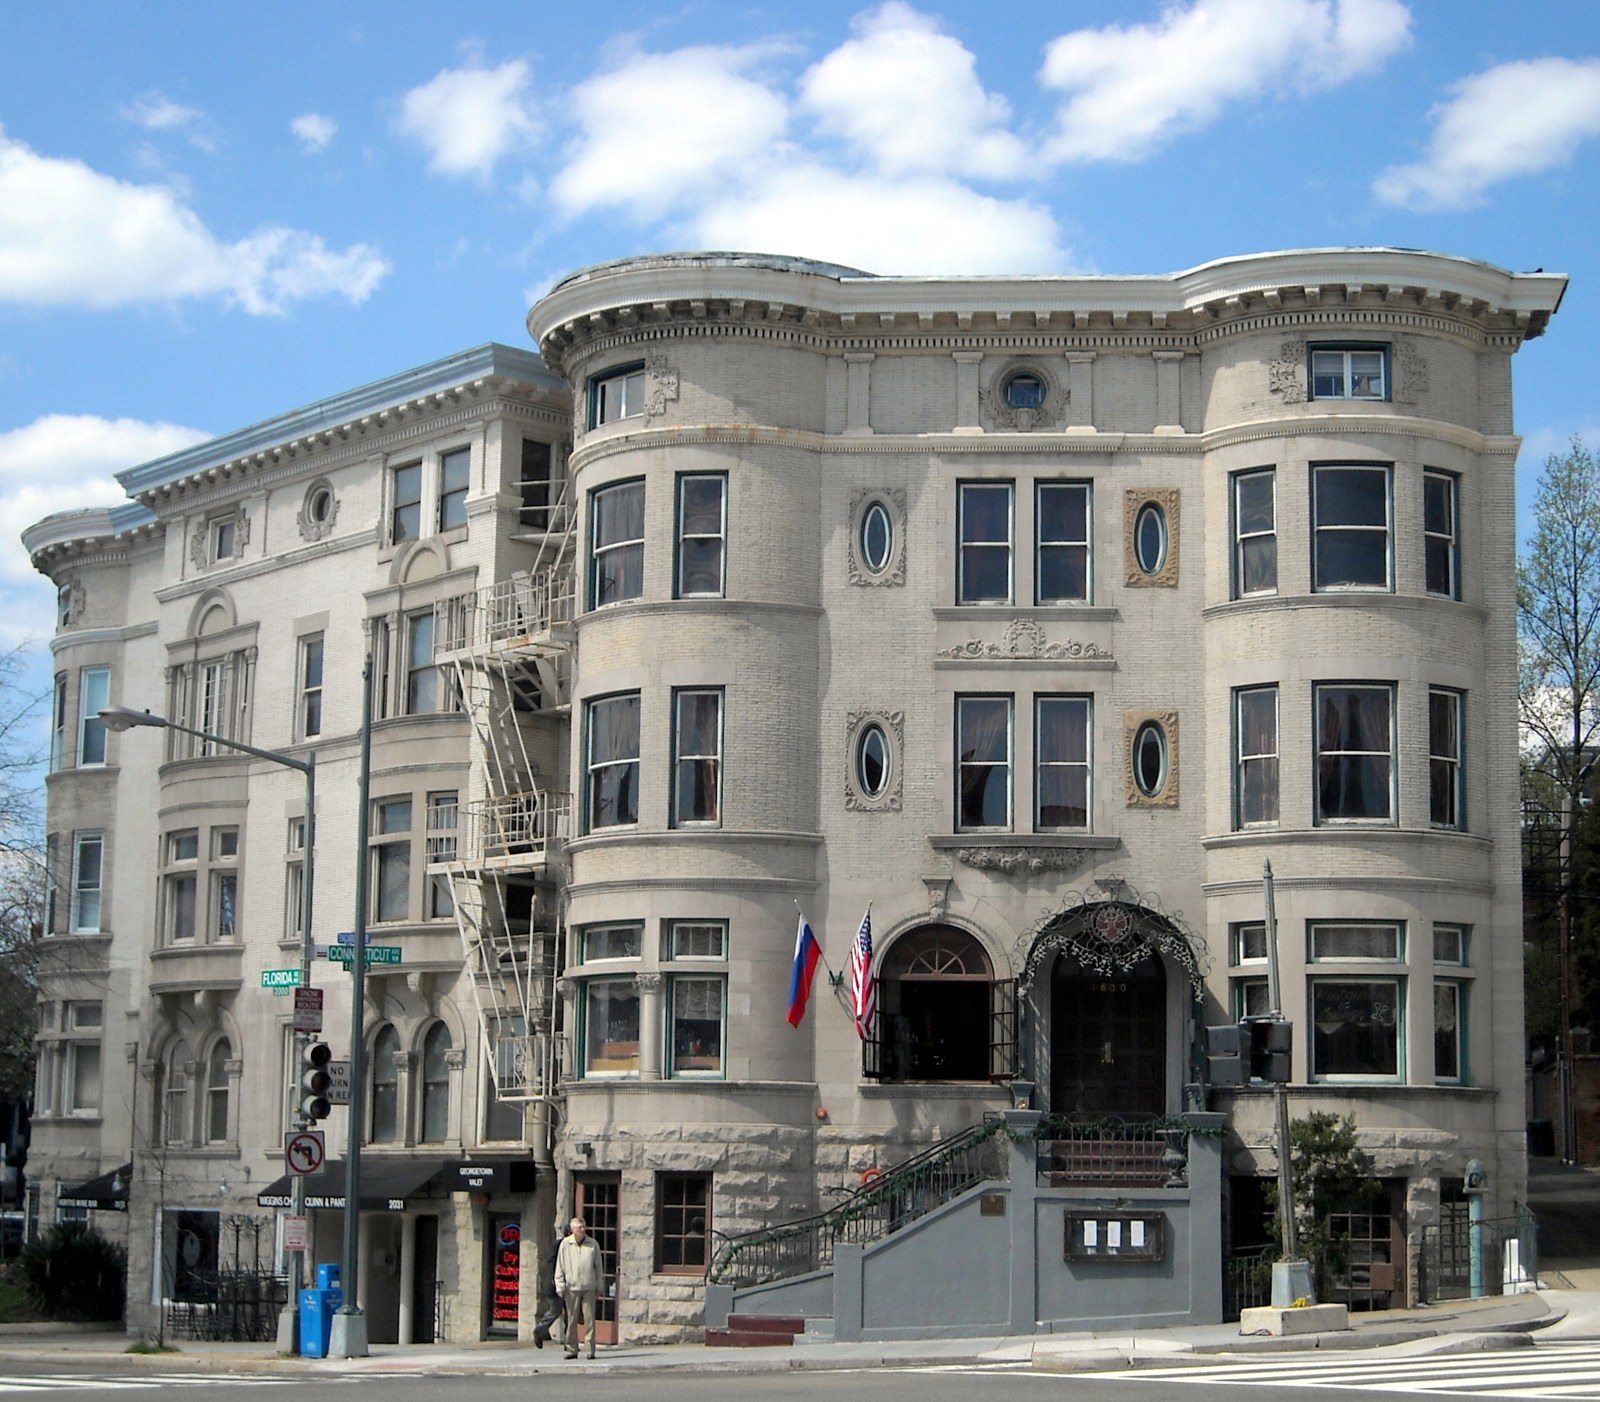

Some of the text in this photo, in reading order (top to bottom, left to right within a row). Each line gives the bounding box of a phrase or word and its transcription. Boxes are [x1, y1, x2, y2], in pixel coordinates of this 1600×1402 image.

[330, 946, 391, 961] CONNTICUT
[263, 971, 293, 986] FLORIDA
[330, 1067, 344, 1075] NO
[331, 1079, 348, 1087] URN
[336, 1091, 350, 1100] RE
[459, 1167, 494, 1176] GEORGETOWN
[468, 1178, 483, 1187] VALET
[258, 1196, 283, 1206] WIGGINS
[305, 1197, 324, 1207] QUINN
[325, 1198, 329, 1207] &
[388, 1199, 404, 1209] 2031
[503, 1251, 518, 1264] Dry
